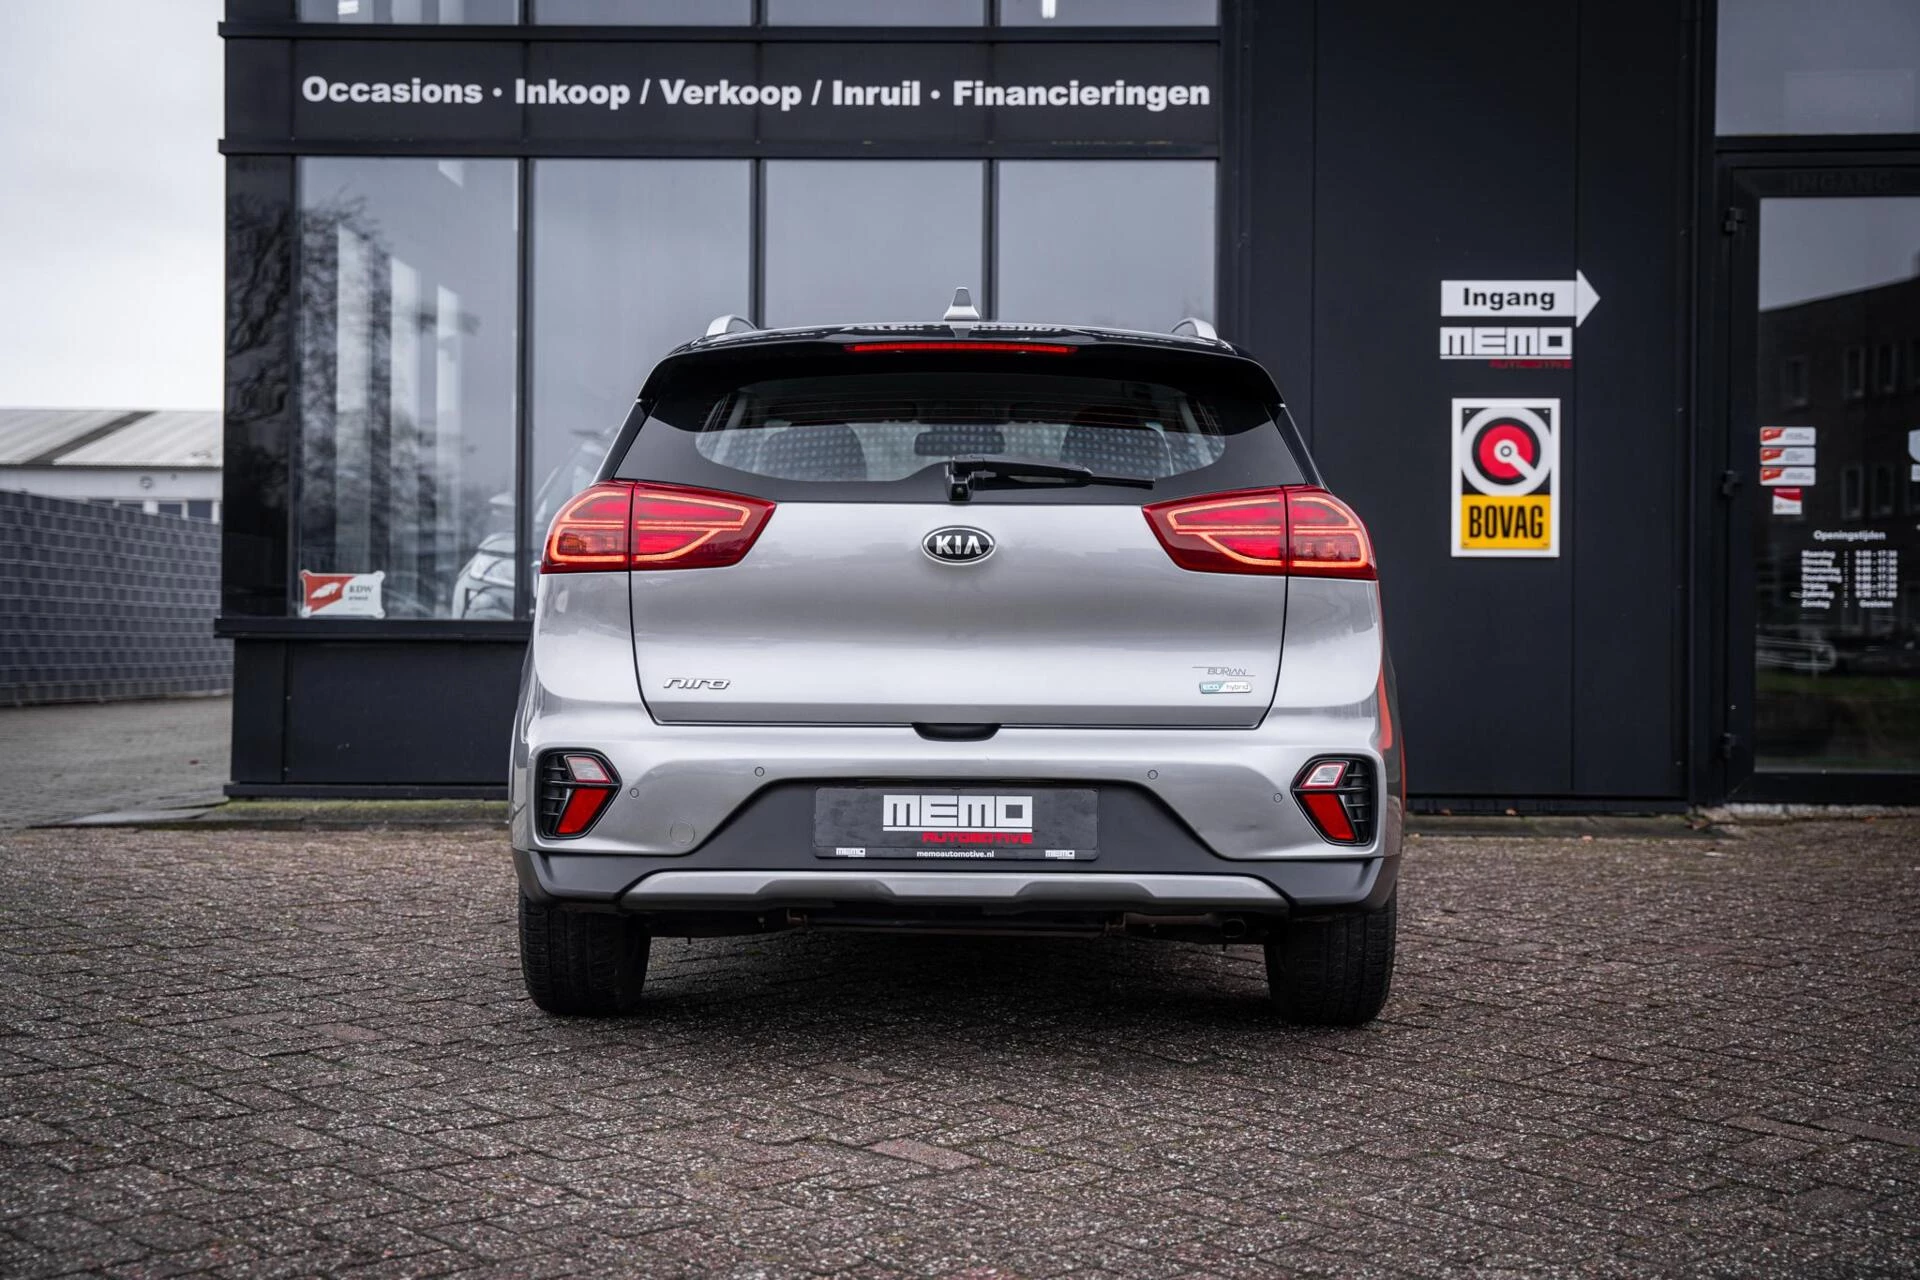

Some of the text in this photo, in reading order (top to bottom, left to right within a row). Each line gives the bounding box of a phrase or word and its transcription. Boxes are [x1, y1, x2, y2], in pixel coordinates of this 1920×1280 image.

[302, 75, 484, 104] Occasions
[515, 78, 631, 111] Inkoop
[659, 78, 803, 112] Verkoop
[832, 79, 921, 107] Inruil
[953, 79, 1210, 112] Financieringen
[1463, 287, 1555, 311] Ingang
[1440, 327, 1572, 356] MEMO
[1469, 505, 1544, 539] BOVAG
[935, 534, 982, 555] KIA
[663, 678, 731, 690] niro
[883, 795, 1032, 828] MEMO
[922, 831, 1033, 844] AUTOMOTIVE
[916, 849, 995, 859] memoautomotive.nl
